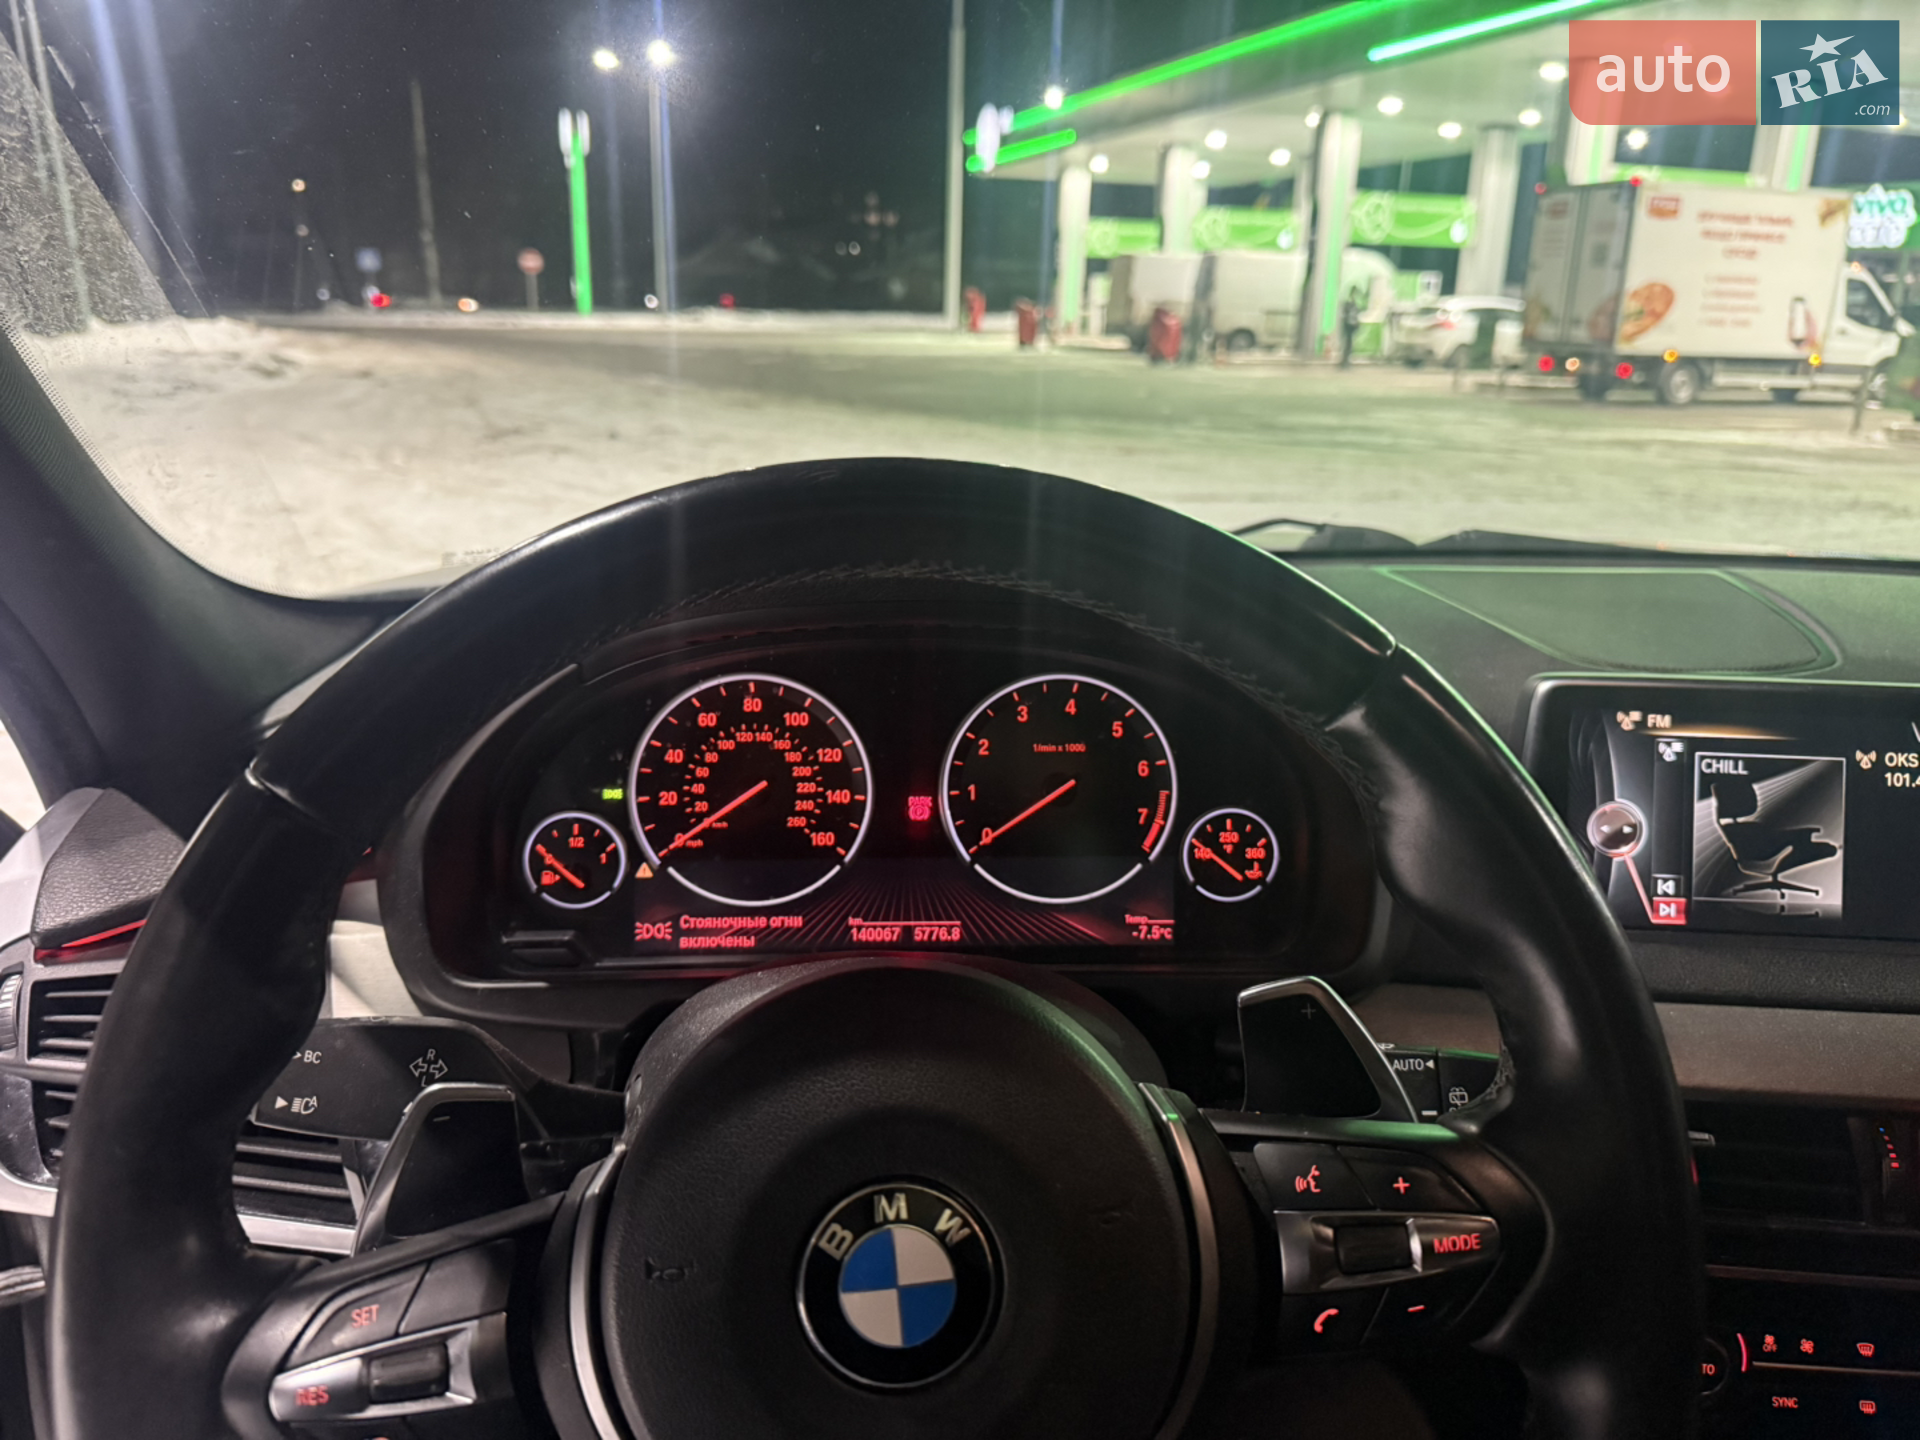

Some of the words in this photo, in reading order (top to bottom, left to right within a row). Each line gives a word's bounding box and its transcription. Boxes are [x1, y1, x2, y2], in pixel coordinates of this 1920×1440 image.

[743, 698, 762, 712] 80
[1065, 698, 1077, 716] 4
[698, 712, 717, 727] 60
[783, 711, 809, 727] 100
[1016, 705, 1029, 723] 3
[1647, 714, 1672, 728] FM
[1111, 721, 1124, 738] 5
[735, 731, 754, 743] 120
[755, 731, 774, 743] 140
[717, 739, 736, 751] 100
[773, 739, 792, 750] 160
[977, 738, 990, 756] 2
[1033, 743, 1057, 752] 1/min
[1065, 743, 1087, 752] 1000
[664, 748, 684, 764] 40
[704, 752, 719, 764] 80
[784, 752, 802, 763] 180
[816, 747, 842, 763] 120
[695, 766, 710, 779] 60
[792, 766, 812, 778] 200
[1137, 759, 1150, 777] 6
[1701, 759, 1748, 775] CHILL
[690, 782, 705, 795] 40
[796, 782, 817, 794] 220
[967, 784, 976, 801] 1
[658, 791, 678, 805] 20
[825, 789, 851, 805] 140
[908, 796, 932, 806] PARK
[694, 800, 709, 813] 20
[795, 800, 815, 812] 240
[786, 816, 807, 828] 260
[1137, 807, 1149, 824] 7
[568, 836, 585, 848] 1/2
[685, 839, 704, 849] mph
[810, 832, 836, 847] 160
[1218, 831, 1240, 844] 250
[599, 852, 608, 865] 1
[679, 914, 767, 929] Стояночные
[769, 916, 803, 928] огни
[850, 926, 901, 942] 140067
[913, 926, 961, 942] 5776.8
[1131, 924, 1173, 940] -7.5°C
[679, 935, 756, 949] включены
[303, 1050, 323, 1065] BC
[427, 1048, 437, 1061] R
[1392, 1058, 1425, 1071] AUTO
[818, 1192, 972, 1261] BMW
[1433, 1233, 1481, 1254] MODE
[350, 1303, 380, 1329] SET
[294, 1383, 331, 1407] RES
[1771, 1395, 1799, 1409] SYNC
